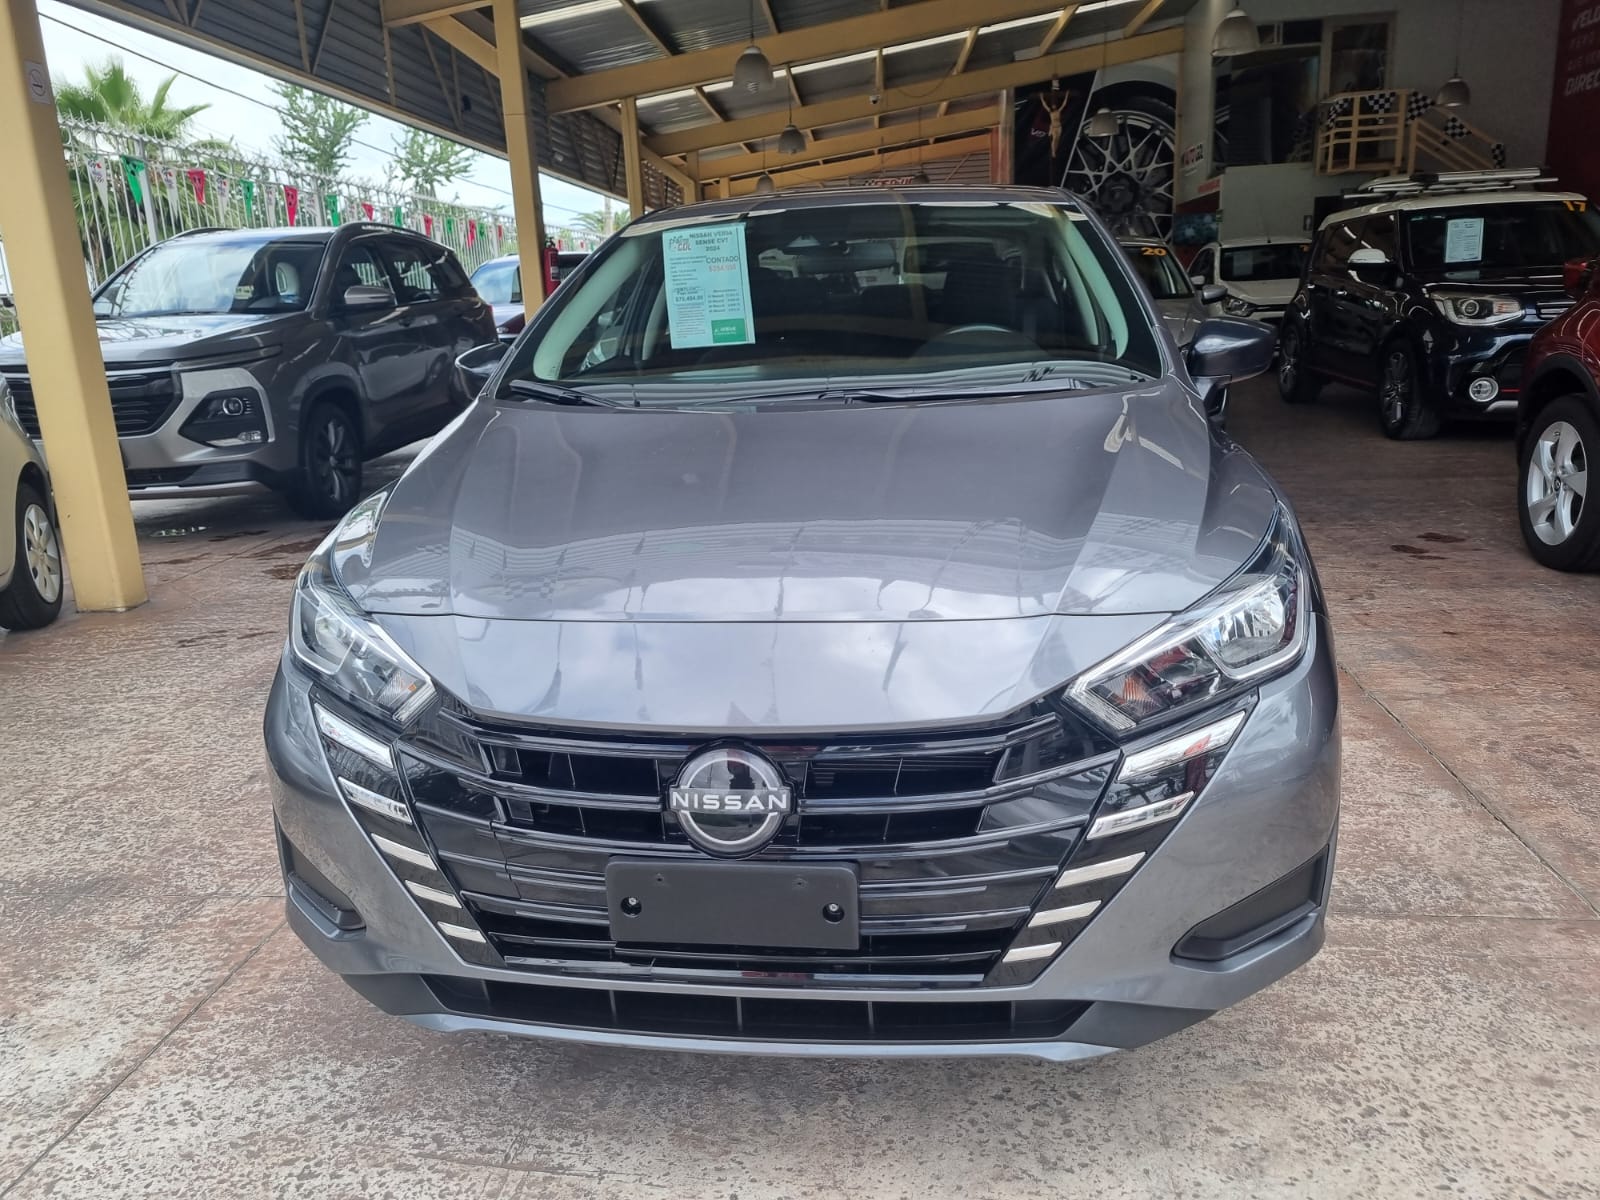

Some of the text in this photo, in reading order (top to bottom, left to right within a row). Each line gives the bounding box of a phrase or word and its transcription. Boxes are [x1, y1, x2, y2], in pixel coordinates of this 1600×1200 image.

[1562, 200, 1586, 212] 17
[689, 231, 713, 239] NISSAN
[1141, 246, 1167, 256] 20
[705, 255, 738, 264] CONTADO
[672, 791, 787, 810] NISSAN
